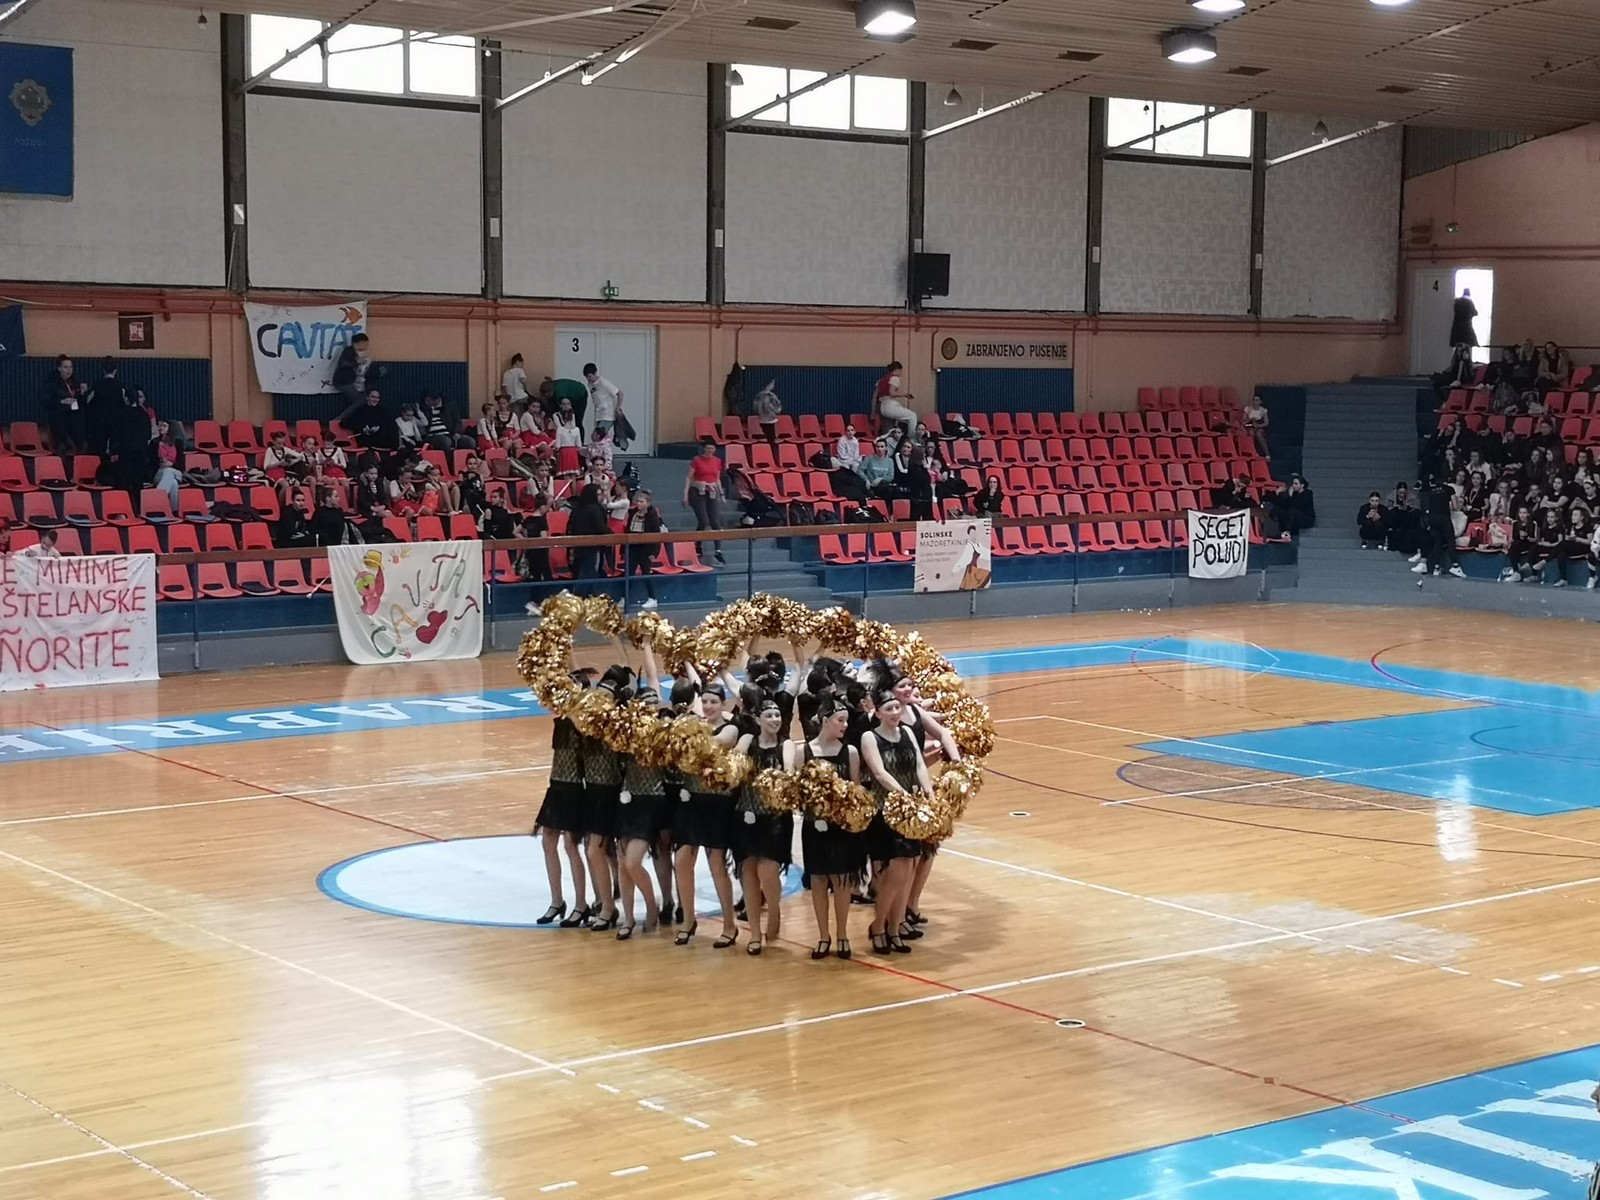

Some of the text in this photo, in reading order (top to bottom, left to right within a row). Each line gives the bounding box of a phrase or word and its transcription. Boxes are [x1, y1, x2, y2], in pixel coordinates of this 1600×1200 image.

[1432, 279, 1439, 292] 4
[572, 337, 580, 353] 3
[966, 343, 1025, 357] ZABRANJENO
[1195, 513, 1246, 540] SEGET
[36, 556, 128, 586] MINIME
[0, 586, 147, 619] ŠTELANSKE
